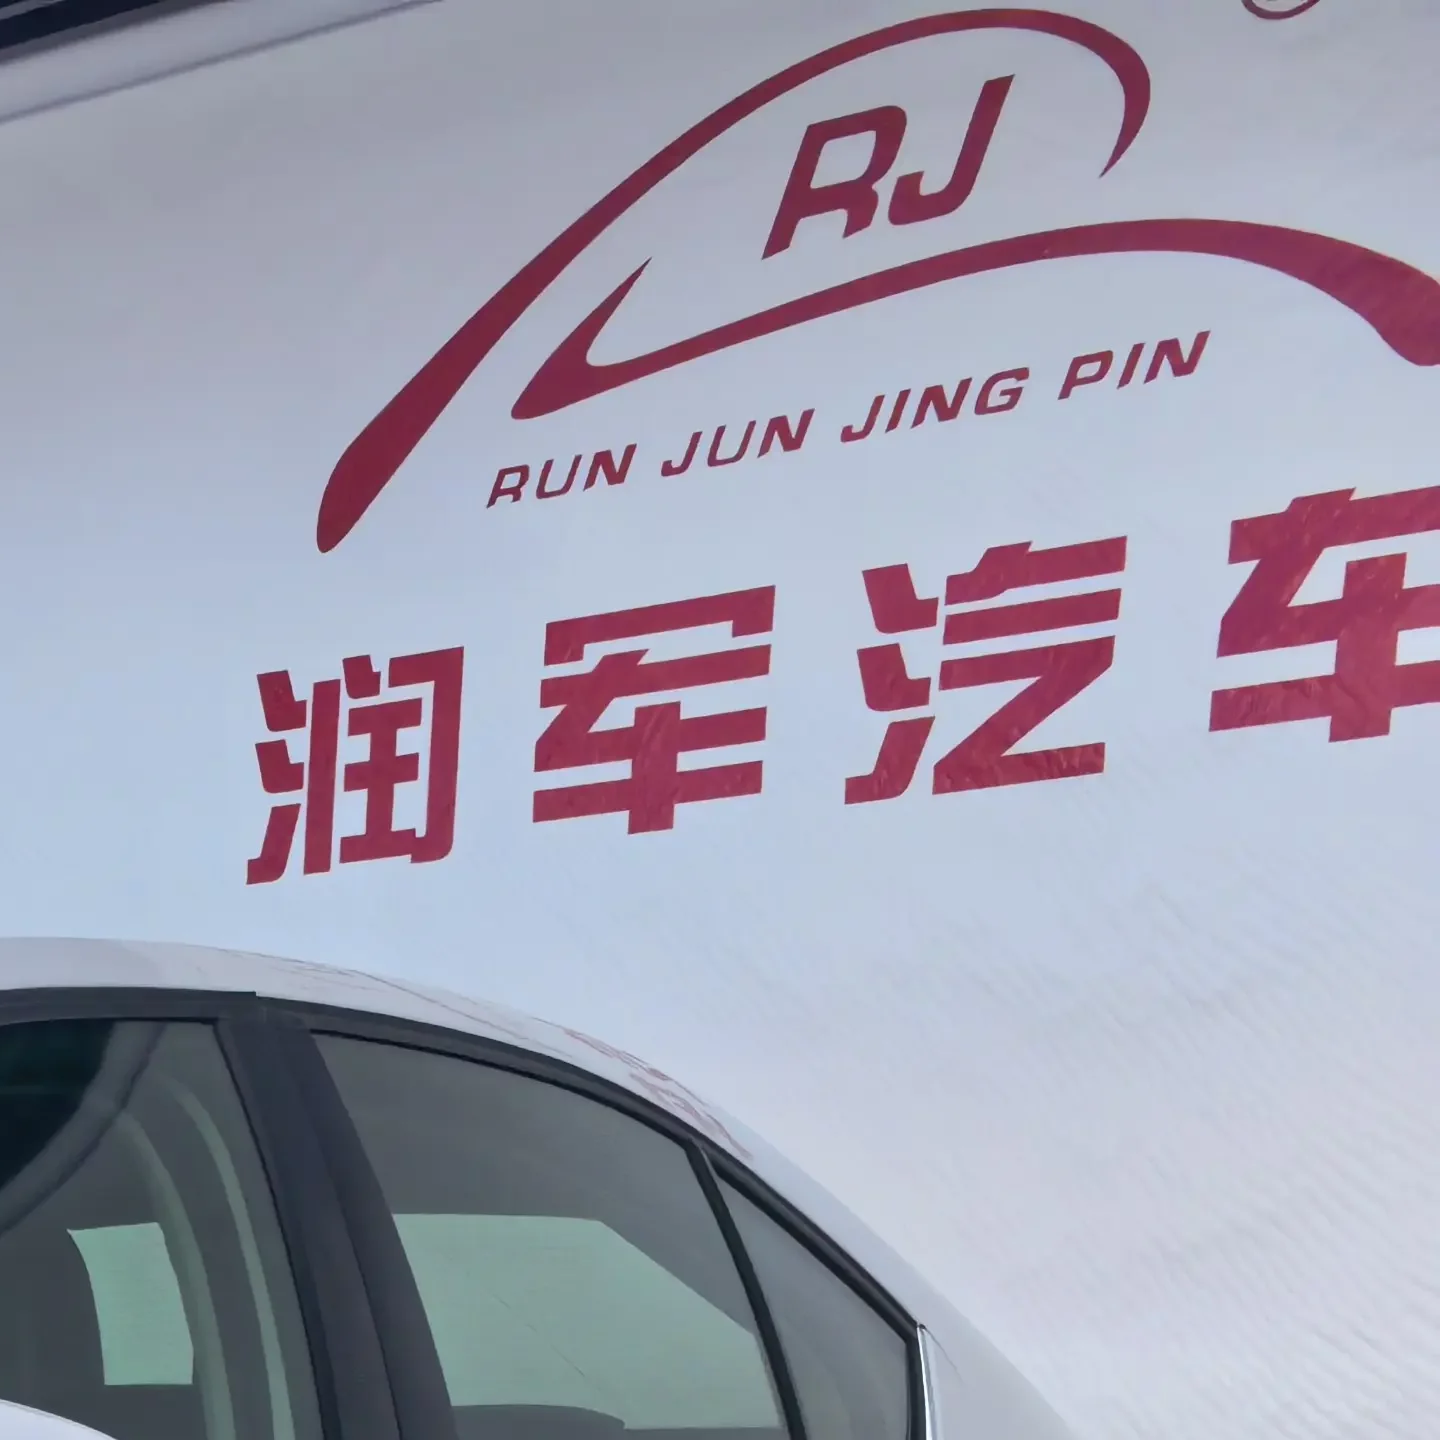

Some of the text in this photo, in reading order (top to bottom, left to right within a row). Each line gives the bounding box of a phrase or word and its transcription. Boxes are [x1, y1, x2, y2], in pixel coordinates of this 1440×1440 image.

[762, 74, 1015, 259] RJ
[486, 330, 1211, 508] RUN JUN JING PIN
[247, 487, 1440, 885] 润军汽车
